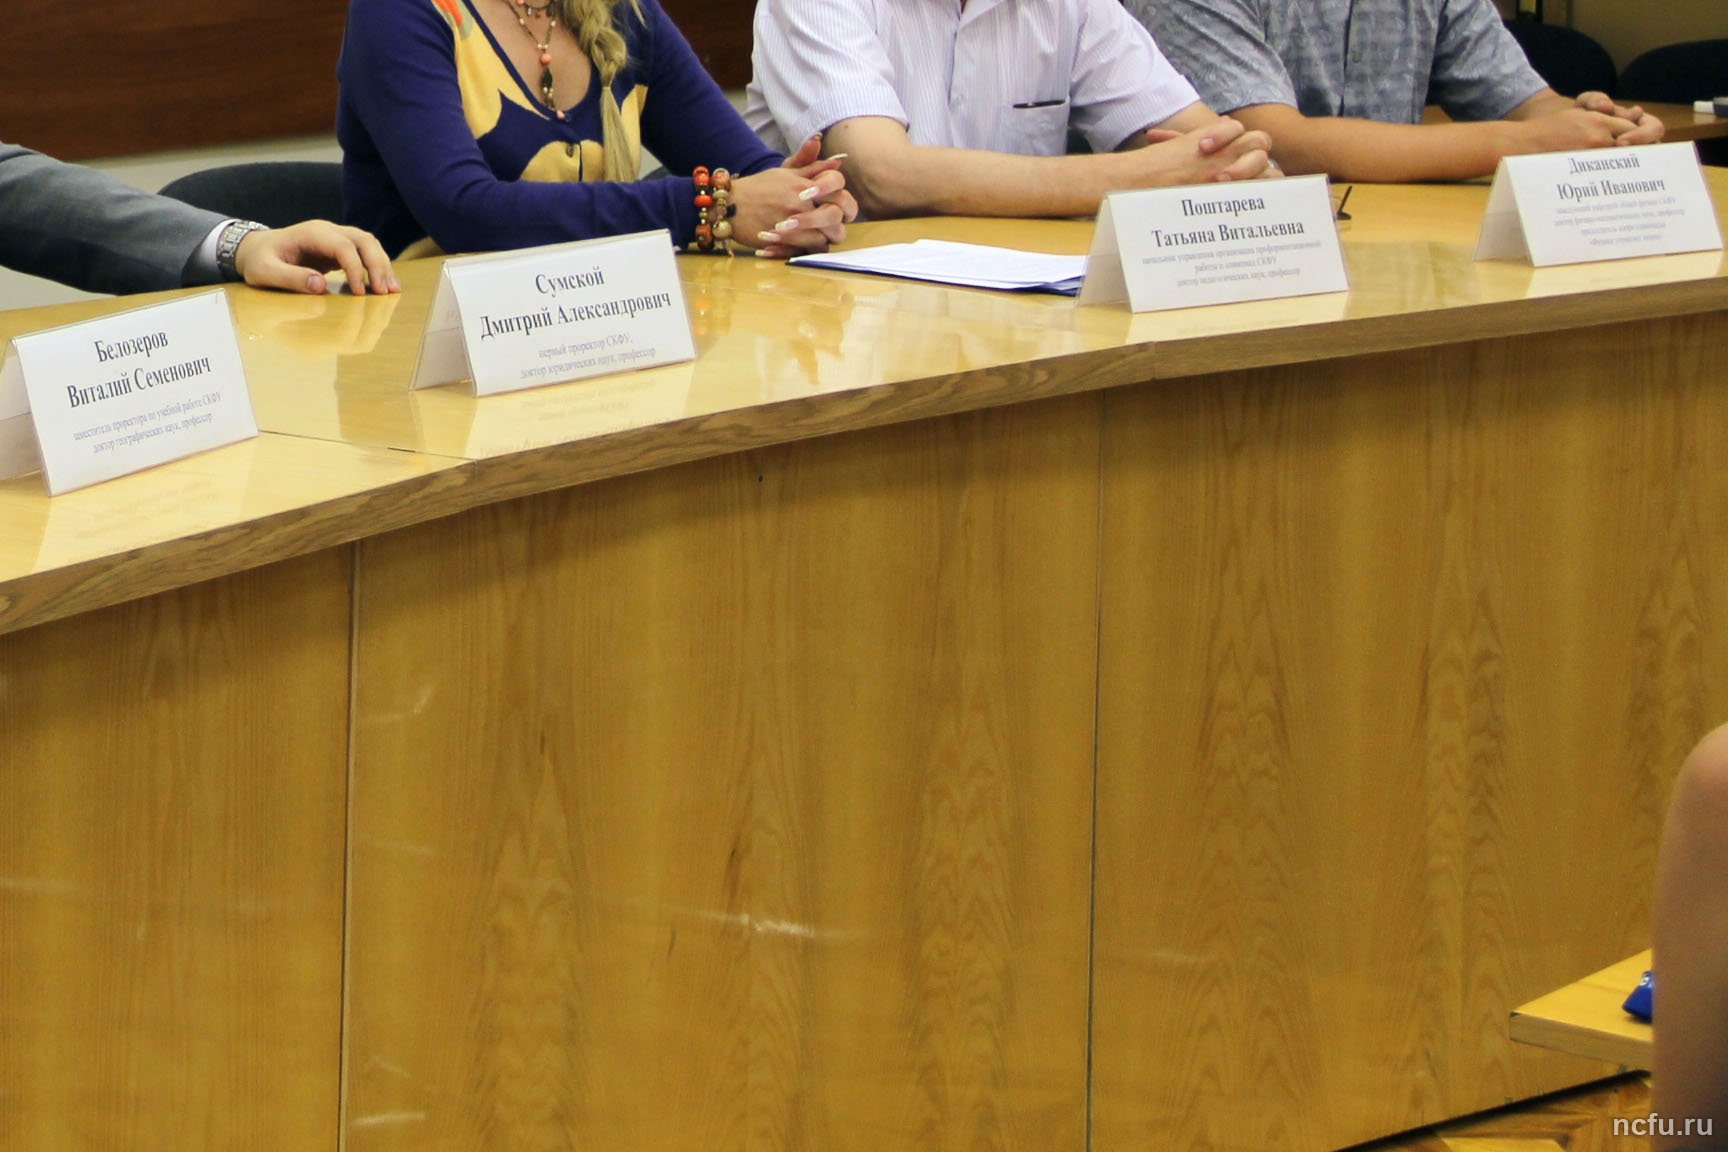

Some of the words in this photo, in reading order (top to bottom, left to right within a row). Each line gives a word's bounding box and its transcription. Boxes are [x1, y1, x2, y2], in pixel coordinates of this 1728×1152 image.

[1570, 154, 1640, 175] Диканский
[1557, 182, 1598, 202] Юрий
[1602, 178, 1666, 196] Иванович
[1181, 197, 1265, 217] Поштарева
[1151, 228, 1215, 248] Татьяна
[1218, 221, 1305, 242] Витальевна
[535, 266, 605, 298] Сумской
[480, 308, 553, 340] Дмитрий
[557, 292, 671, 325] Александрович
[94, 331, 168, 363] Белозеров
[67, 373, 132, 408] Виталий
[134, 357, 211, 390] Семенович
